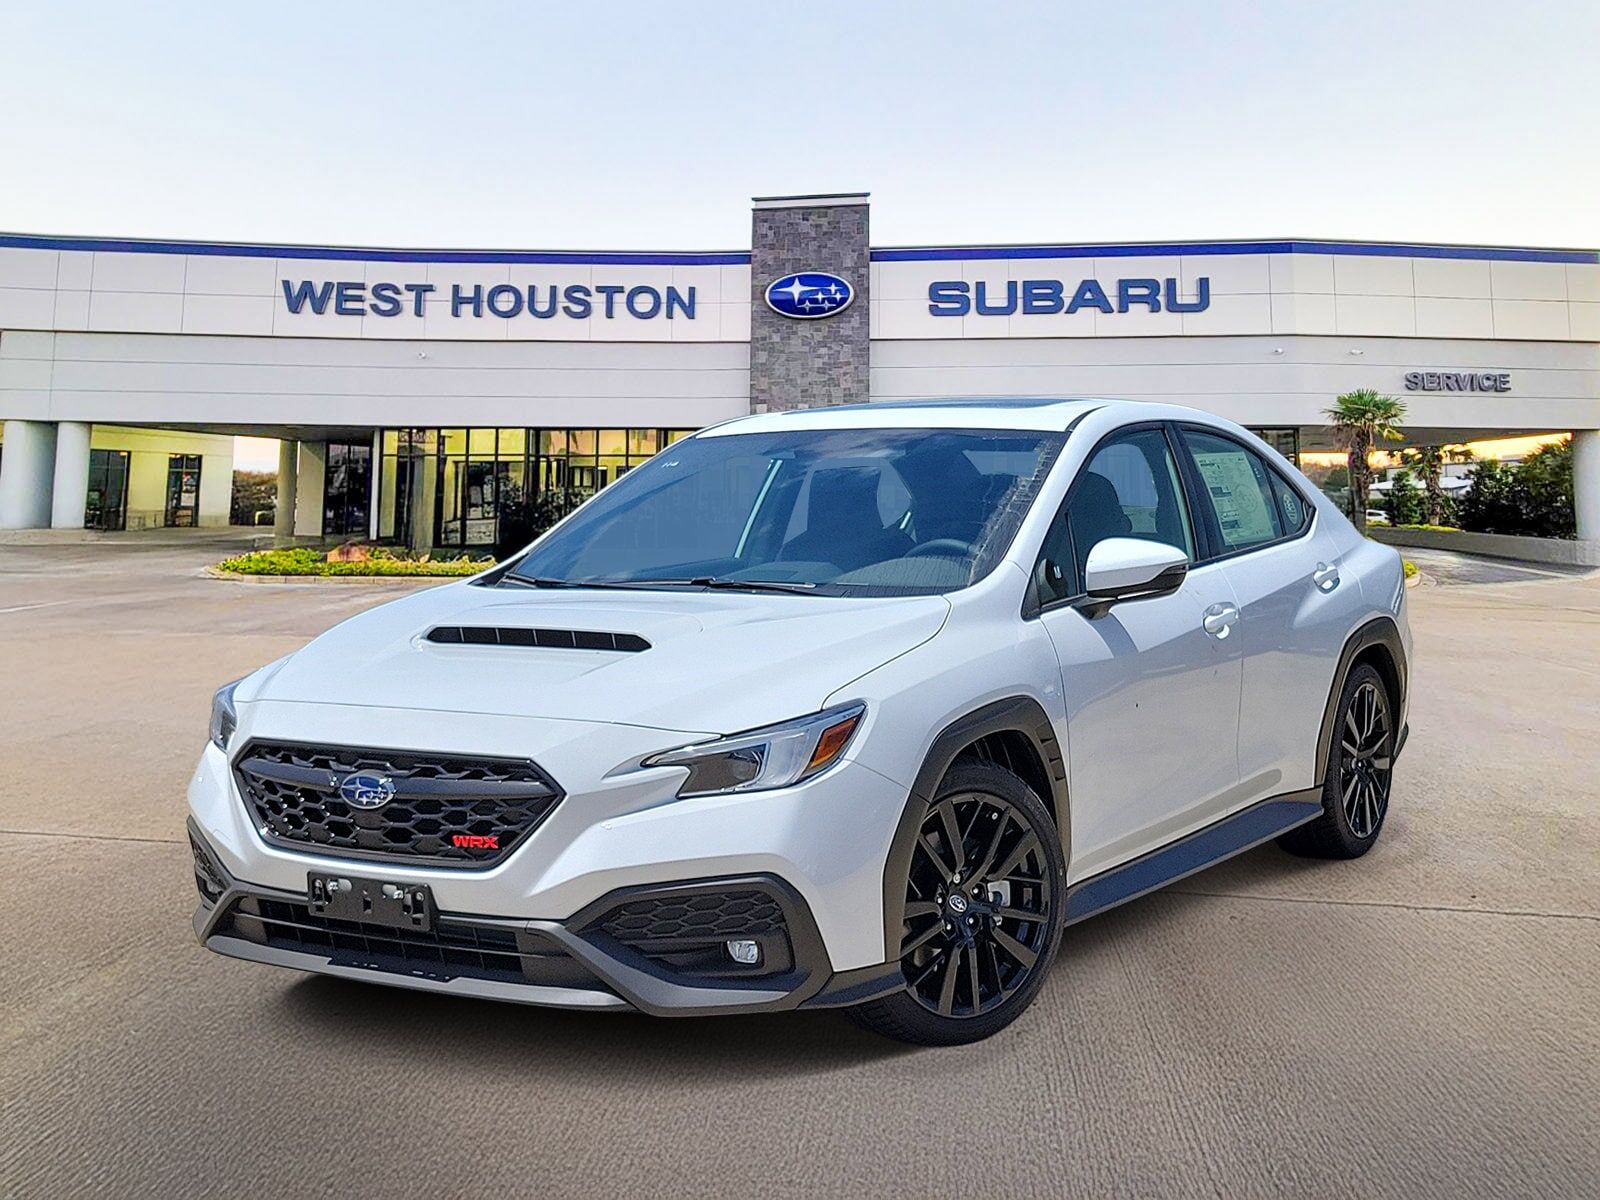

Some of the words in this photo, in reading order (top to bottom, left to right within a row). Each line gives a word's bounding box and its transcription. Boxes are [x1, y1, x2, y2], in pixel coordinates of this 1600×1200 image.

[282, 279, 435, 318] WEST
[450, 284, 696, 320] HOUSTON
[928, 277, 1210, 316] SUBARU
[1404, 372, 1512, 392] SERVICE
[452, 835, 499, 849] WRX
